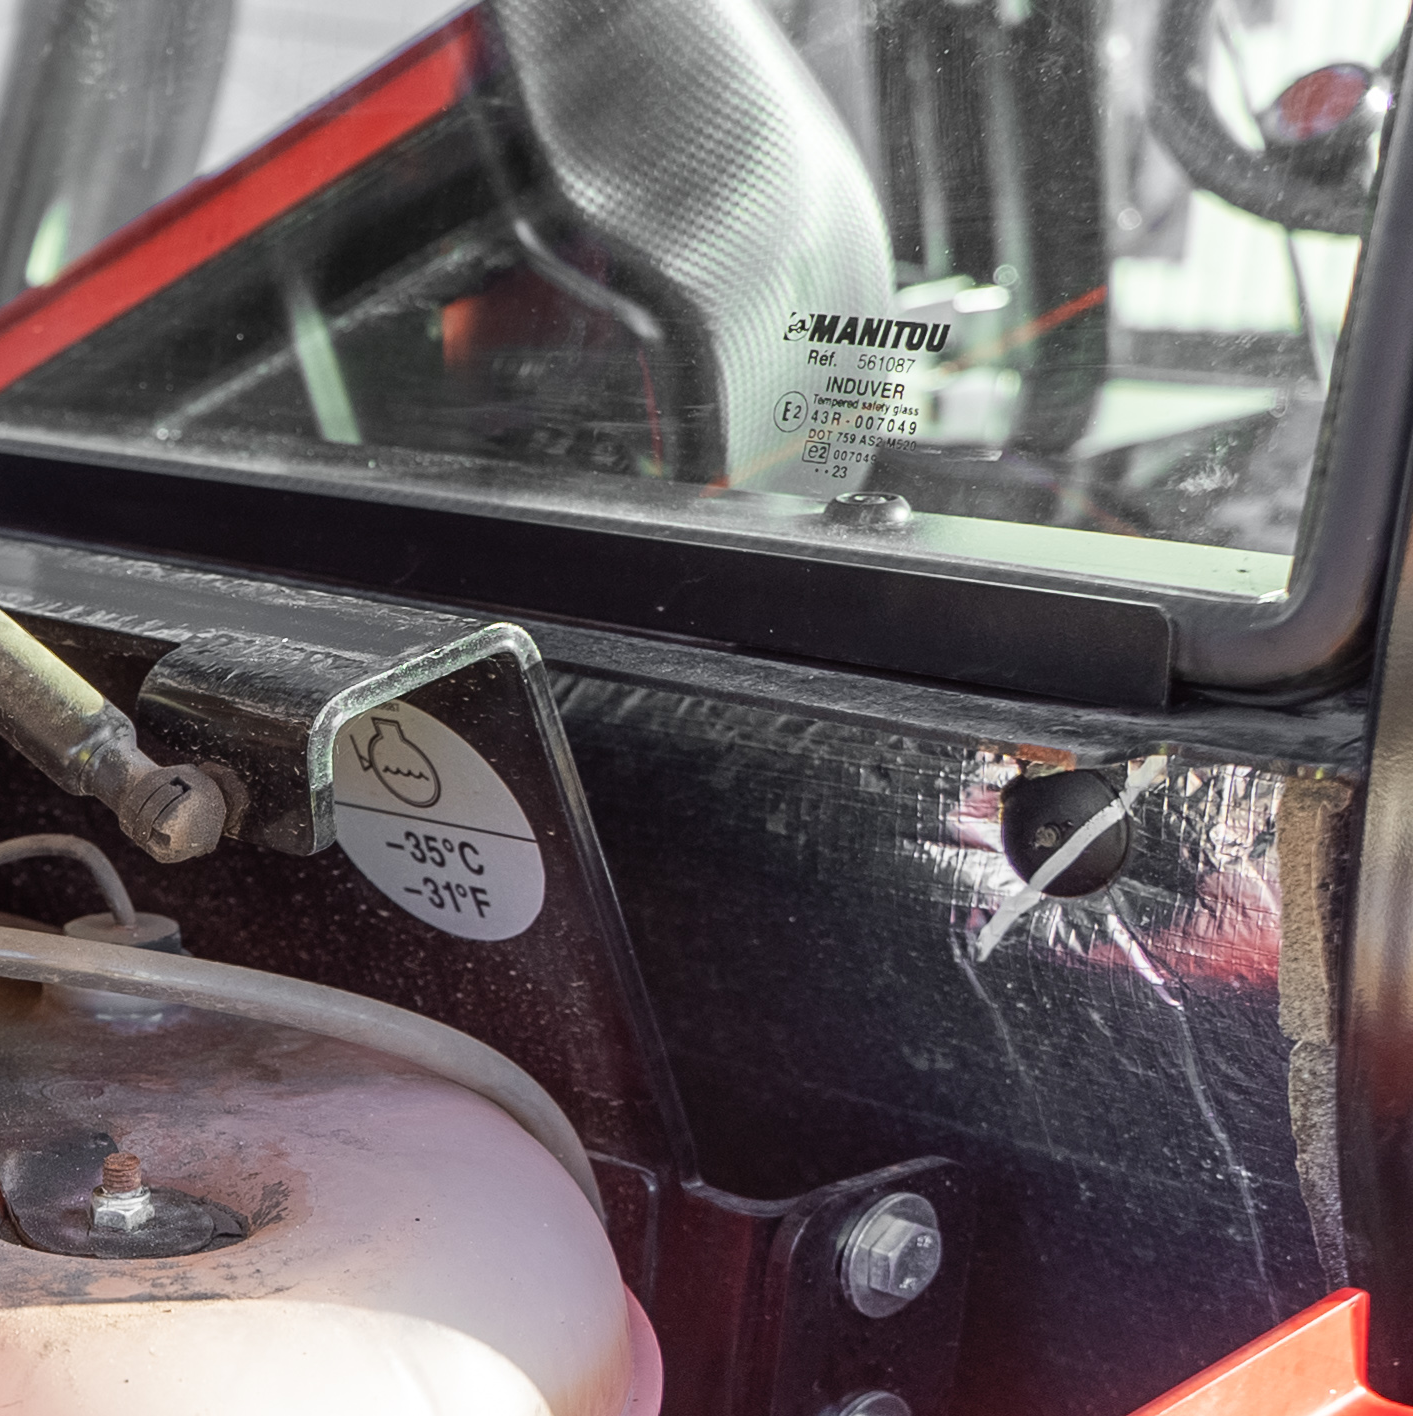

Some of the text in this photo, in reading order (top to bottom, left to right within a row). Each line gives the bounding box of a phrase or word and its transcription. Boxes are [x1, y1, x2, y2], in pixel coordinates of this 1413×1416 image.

[808, 314, 951, 353] MANITOU
[857, 353, 916, 373] 561087
[826, 376, 905, 400] INDUVER
[814, 394, 919, 417] Tempered safety glass
[808, 428, 833, 440] DOT
